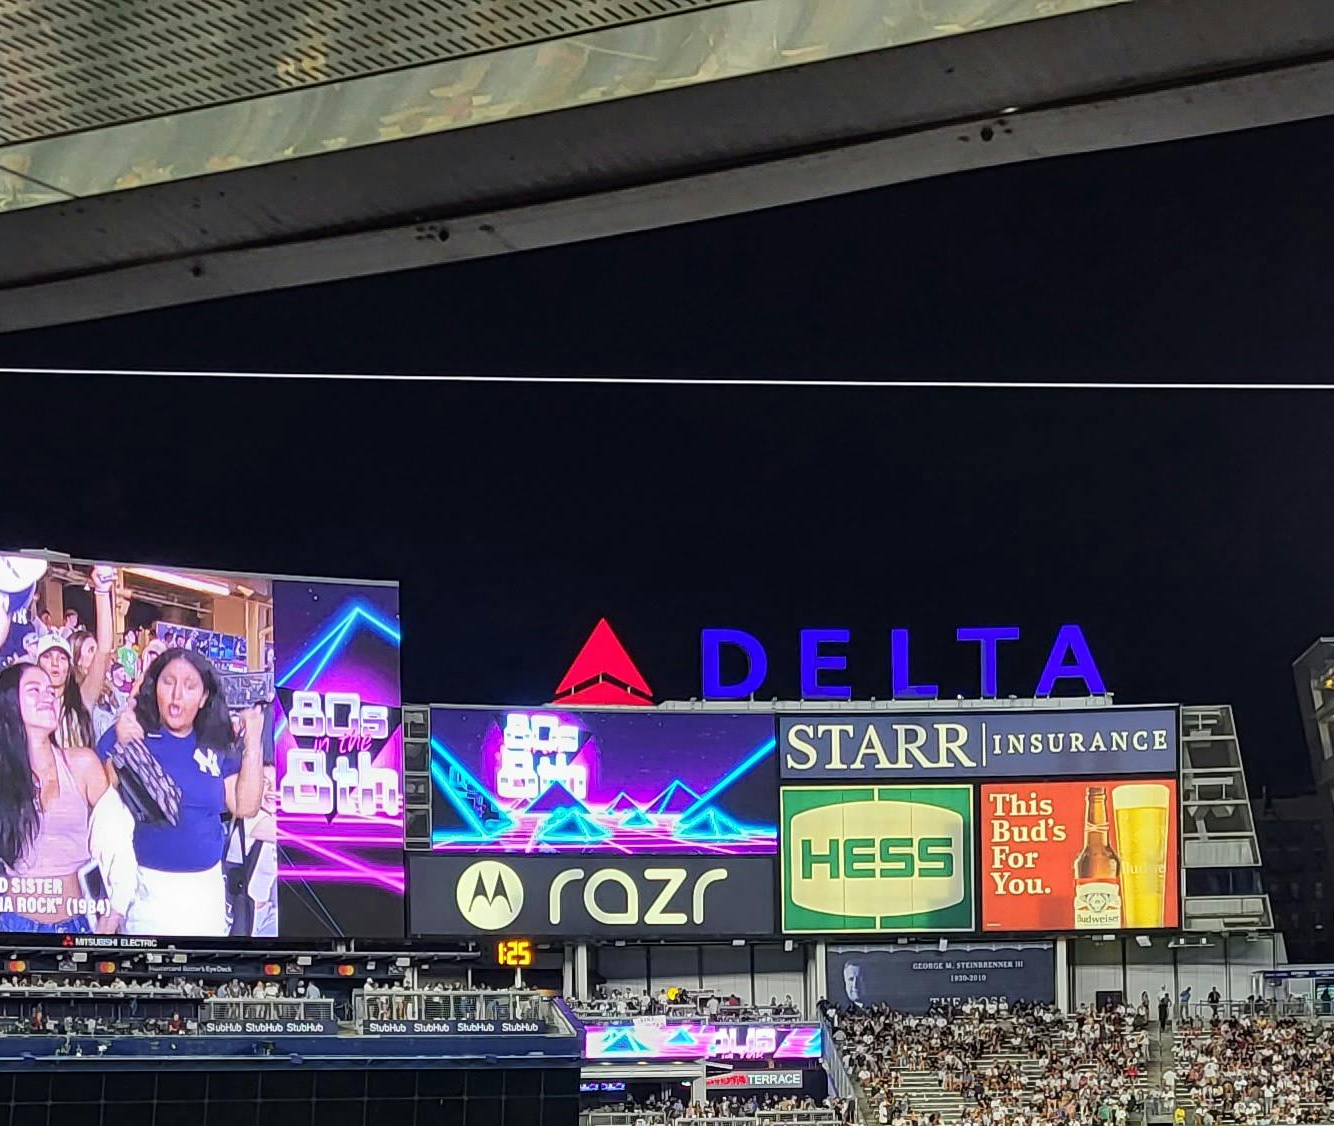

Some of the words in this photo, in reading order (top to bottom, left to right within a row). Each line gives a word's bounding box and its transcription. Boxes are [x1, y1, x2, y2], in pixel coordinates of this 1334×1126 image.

[701, 625, 1107, 699] DELTA
[288, 690, 389, 739] 80s
[314, 736, 330, 753] in
[338, 729, 373, 754] the
[785, 722, 977, 770] STARR
[992, 729, 1169, 755] INSURANCE
[280, 748, 399, 817] 8th
[989, 793, 1054, 818] This
[801, 836, 954, 879] HESS
[991, 846, 1039, 869] For
[11, 877, 63, 895] SISTER
[991, 871, 1052, 896] You.
[16, 896, 63, 914] ROCK"
[66, 898, 111, 917] (1984)
[550, 867, 728, 925] razr
[75, 937, 117, 947] MITSUBISHI
[120, 938, 158, 947] ELECTRIC
[498, 941, 532, 965] 1:25
[912, 962, 943, 970] GEORGE
[956, 961, 1013, 969] STEINBRENNER
[206, 1022, 242, 1033] StubHub
[245, 1022, 283, 1033] StubHub
[286, 1022, 324, 1033] StubHub
[369, 1022, 407, 1033] StubHub
[414, 1022, 451, 1033] StubHub
[457, 1022, 495, 1033] StubHub
[502, 1022, 539, 1033] StubHub
[748, 1074, 802, 1084] TERRACE
